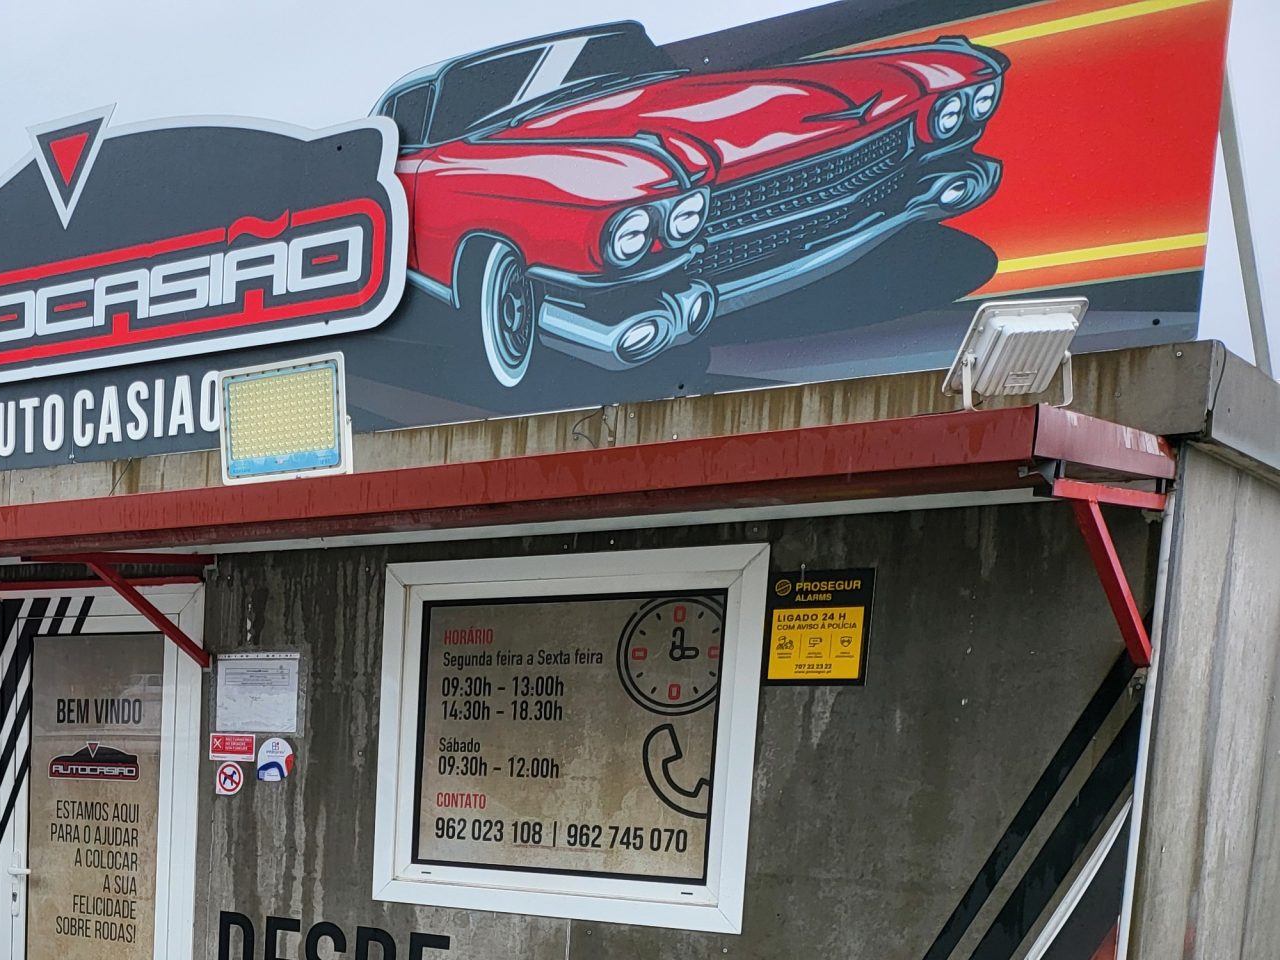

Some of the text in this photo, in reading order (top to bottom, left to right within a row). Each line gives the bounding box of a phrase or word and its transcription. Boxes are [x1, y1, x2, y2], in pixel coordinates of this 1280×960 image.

[795, 580, 862, 591] PROSEGUR
[795, 593, 832, 602] ALARMS
[777, 612, 846, 622] LIGADO 24 H
[828, 620, 857, 629] POLÍCIA
[444, 626, 494, 645] HORÁRIO
[443, 648, 603, 670] Segunda feira a Sexta feira
[441, 677, 491, 697] 09:30h
[512, 676, 564, 697] 13:00h
[57, 698, 142, 725] BEM VINDO
[441, 700, 490, 720] 14:30h
[511, 700, 563, 720] 18.30h
[439, 737, 480, 753] Sábado
[438, 755, 487, 777] 09:30h
[508, 757, 559, 778] 12:00h
[437, 792, 486, 809] CONTATO
[56, 800, 139, 824] ESTAMOS AQUI
[50, 822, 138, 847] PARA O AJUDAR
[435, 817, 466, 840] 962
[471, 818, 504, 842] 023
[511, 821, 543, 844] 108
[567, 824, 602, 848] 962
[608, 825, 644, 850] 745
[650, 828, 688, 853] 070
[74, 848, 138, 872] A COLOCAR
[103, 874, 137, 896] A SUA
[73, 895, 136, 920] FELICIDADE
[56, 916, 136, 944] SOBRE RODAS!
